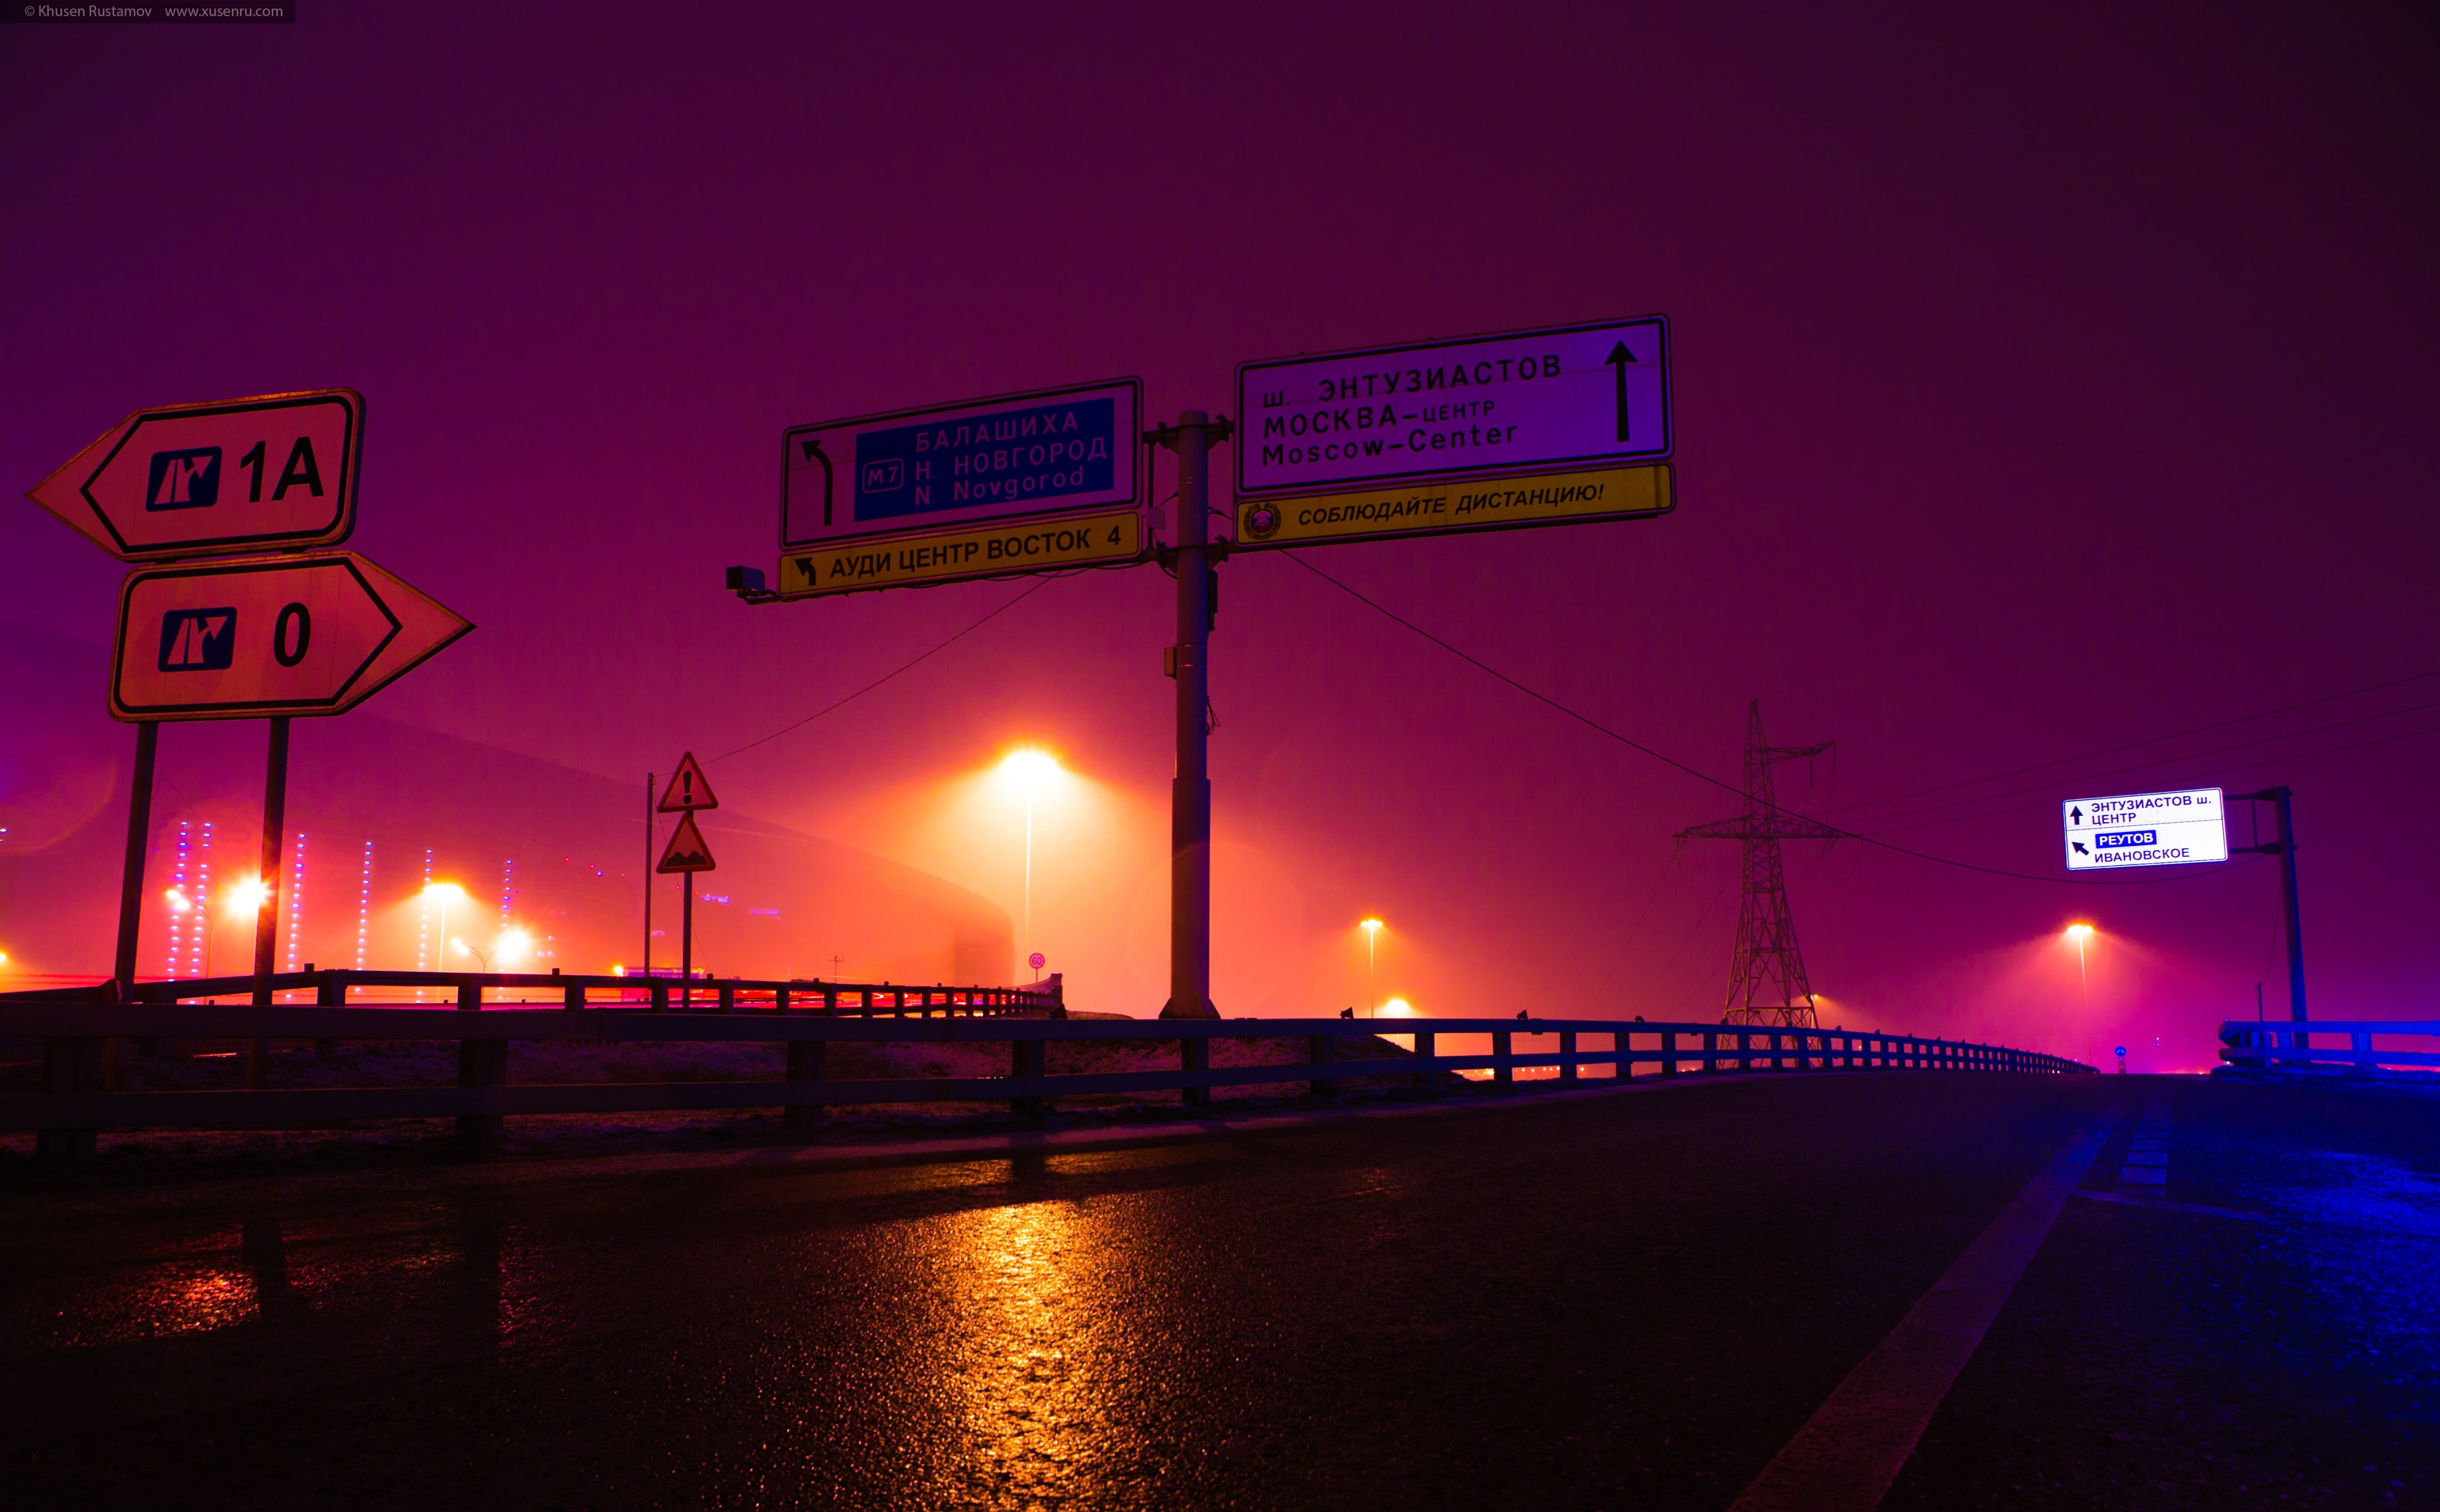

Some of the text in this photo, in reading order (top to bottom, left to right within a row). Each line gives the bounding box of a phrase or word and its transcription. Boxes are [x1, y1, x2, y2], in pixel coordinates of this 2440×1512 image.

[1264, 355, 1561, 408] ш. ЭНТУЗИАСТОВ
[915, 411, 1078, 453] БАЛАШИХА
[954, 436, 1108, 476] НОВГОРОД
[954, 466, 1084, 500] Novgorod
[1298, 484, 1605, 526] СОБЛЮДАЙТЕ ДИСТАНЦИЮ!
[830, 525, 1121, 578] АУДИ ЦЕНТР ВОСТОК 4
[274, 602, 311, 667] 0
[2091, 796, 2212, 812] ЭНТУЗИАСТОВ ш.
[2092, 813, 2136, 826] ЦЕНТР
[2094, 848, 2190, 863] ИВАНОВСКОЕ
[2099, 832, 2154, 846] РЕУТОВ
[1032, 957, 1042, 965] 60
